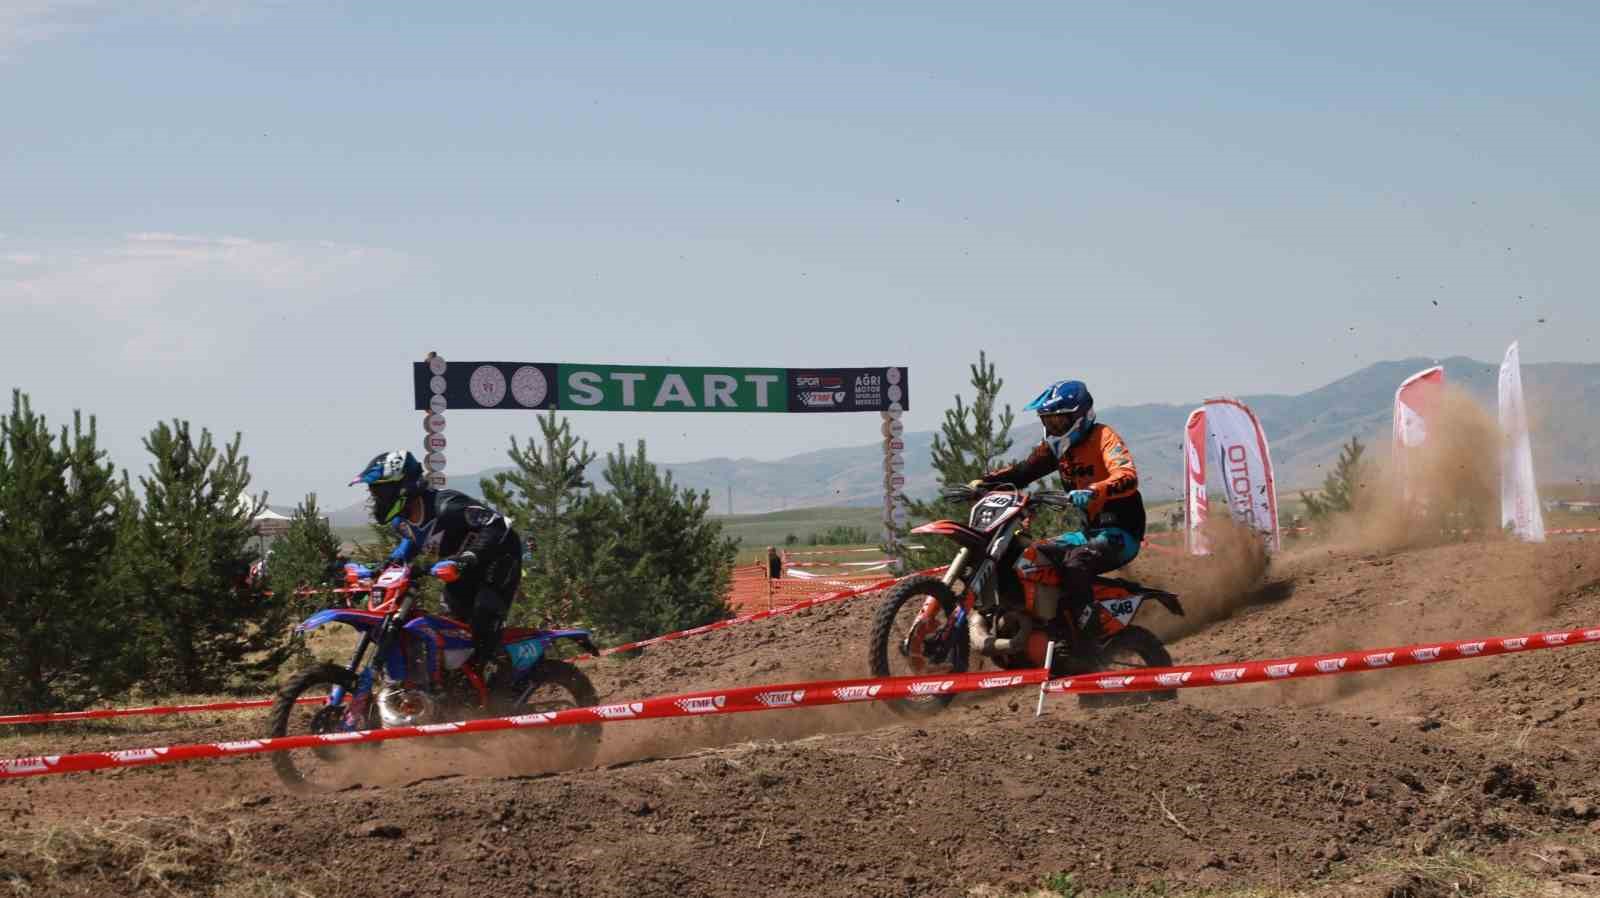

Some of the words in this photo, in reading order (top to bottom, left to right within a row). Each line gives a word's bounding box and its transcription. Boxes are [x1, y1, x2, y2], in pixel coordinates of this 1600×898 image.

[567, 371, 779, 407] START
[1110, 600, 1133, 617] 548
[607, 704, 627, 715] TMF
[691, 697, 712, 708] TMF
